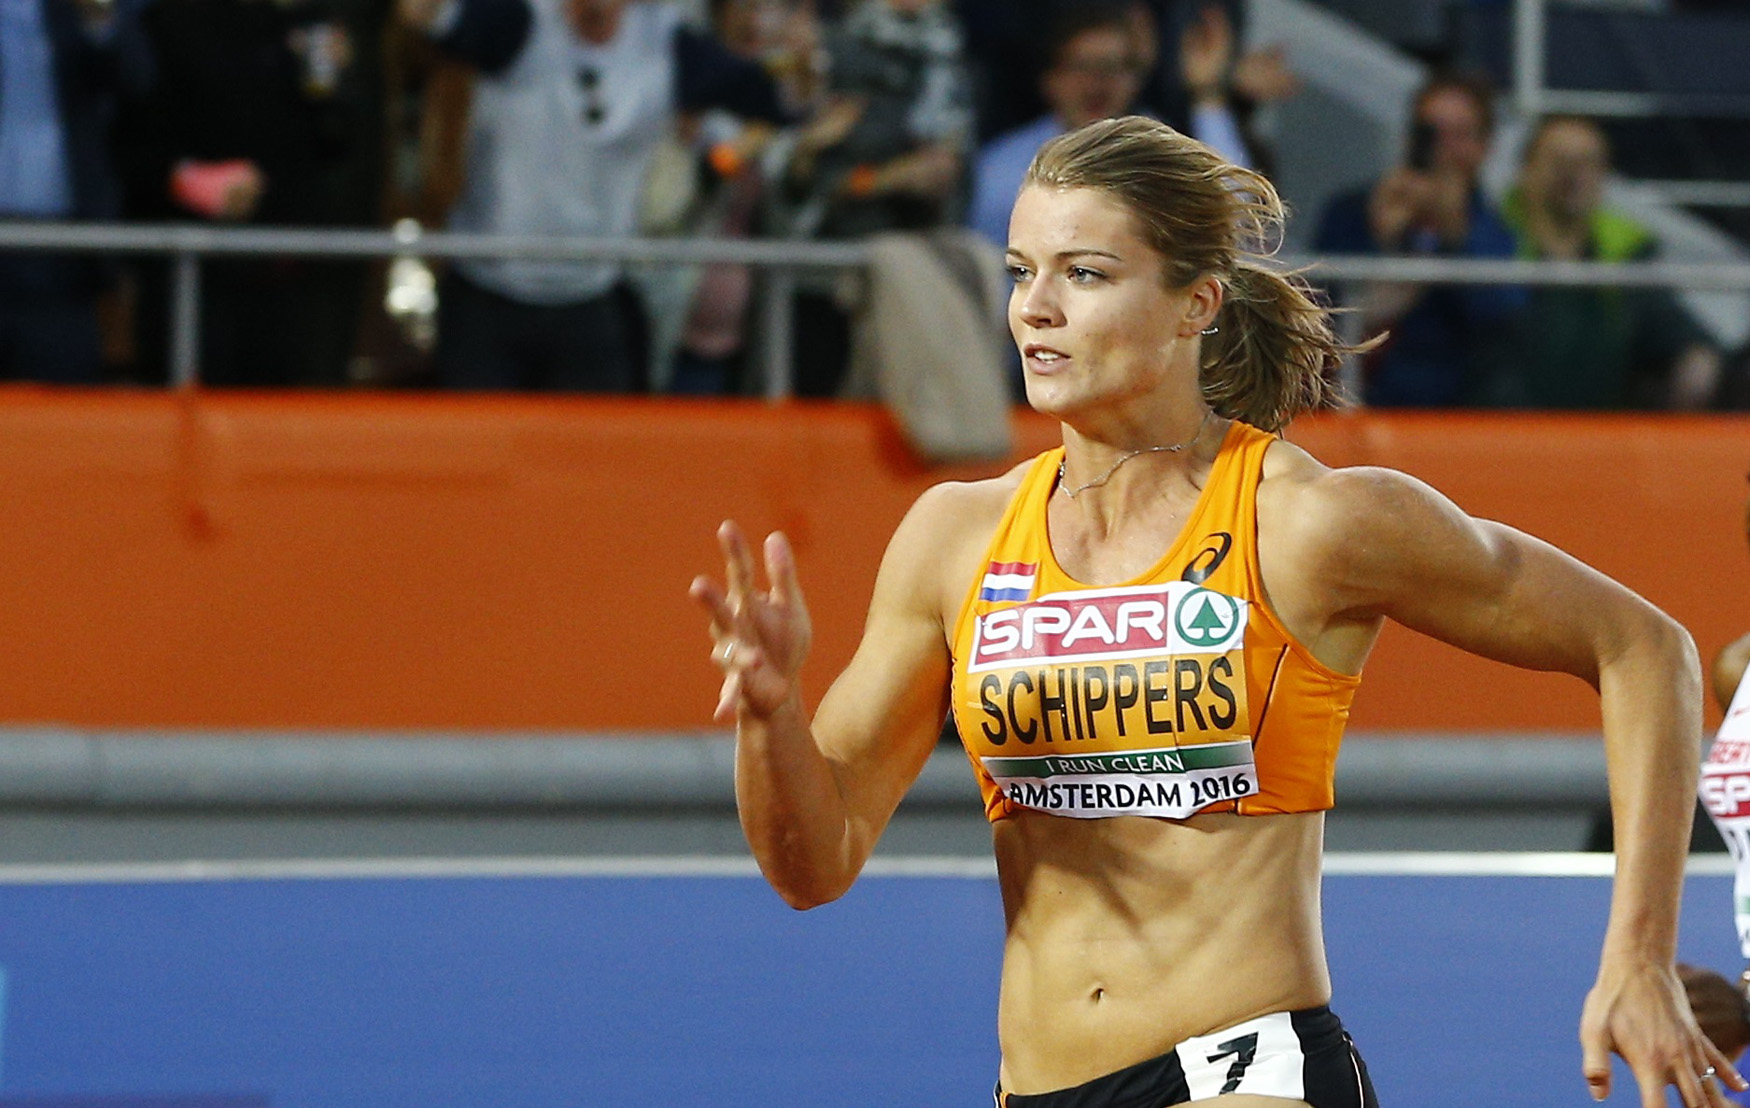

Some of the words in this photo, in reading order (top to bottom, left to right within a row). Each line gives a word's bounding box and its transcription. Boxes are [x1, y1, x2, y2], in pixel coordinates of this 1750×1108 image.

[980, 601, 1166, 656] SPAR
[979, 655, 1237, 747] SCHIPPERS
[1044, 759, 1054, 774] I
[1060, 758, 1108, 774] RUN
[1111, 752, 1185, 774] CLEAN
[1009, 782, 1182, 810] AMSTERDAM
[1190, 773, 1251, 807] 2016
[1205, 1030, 1259, 1096] 7
